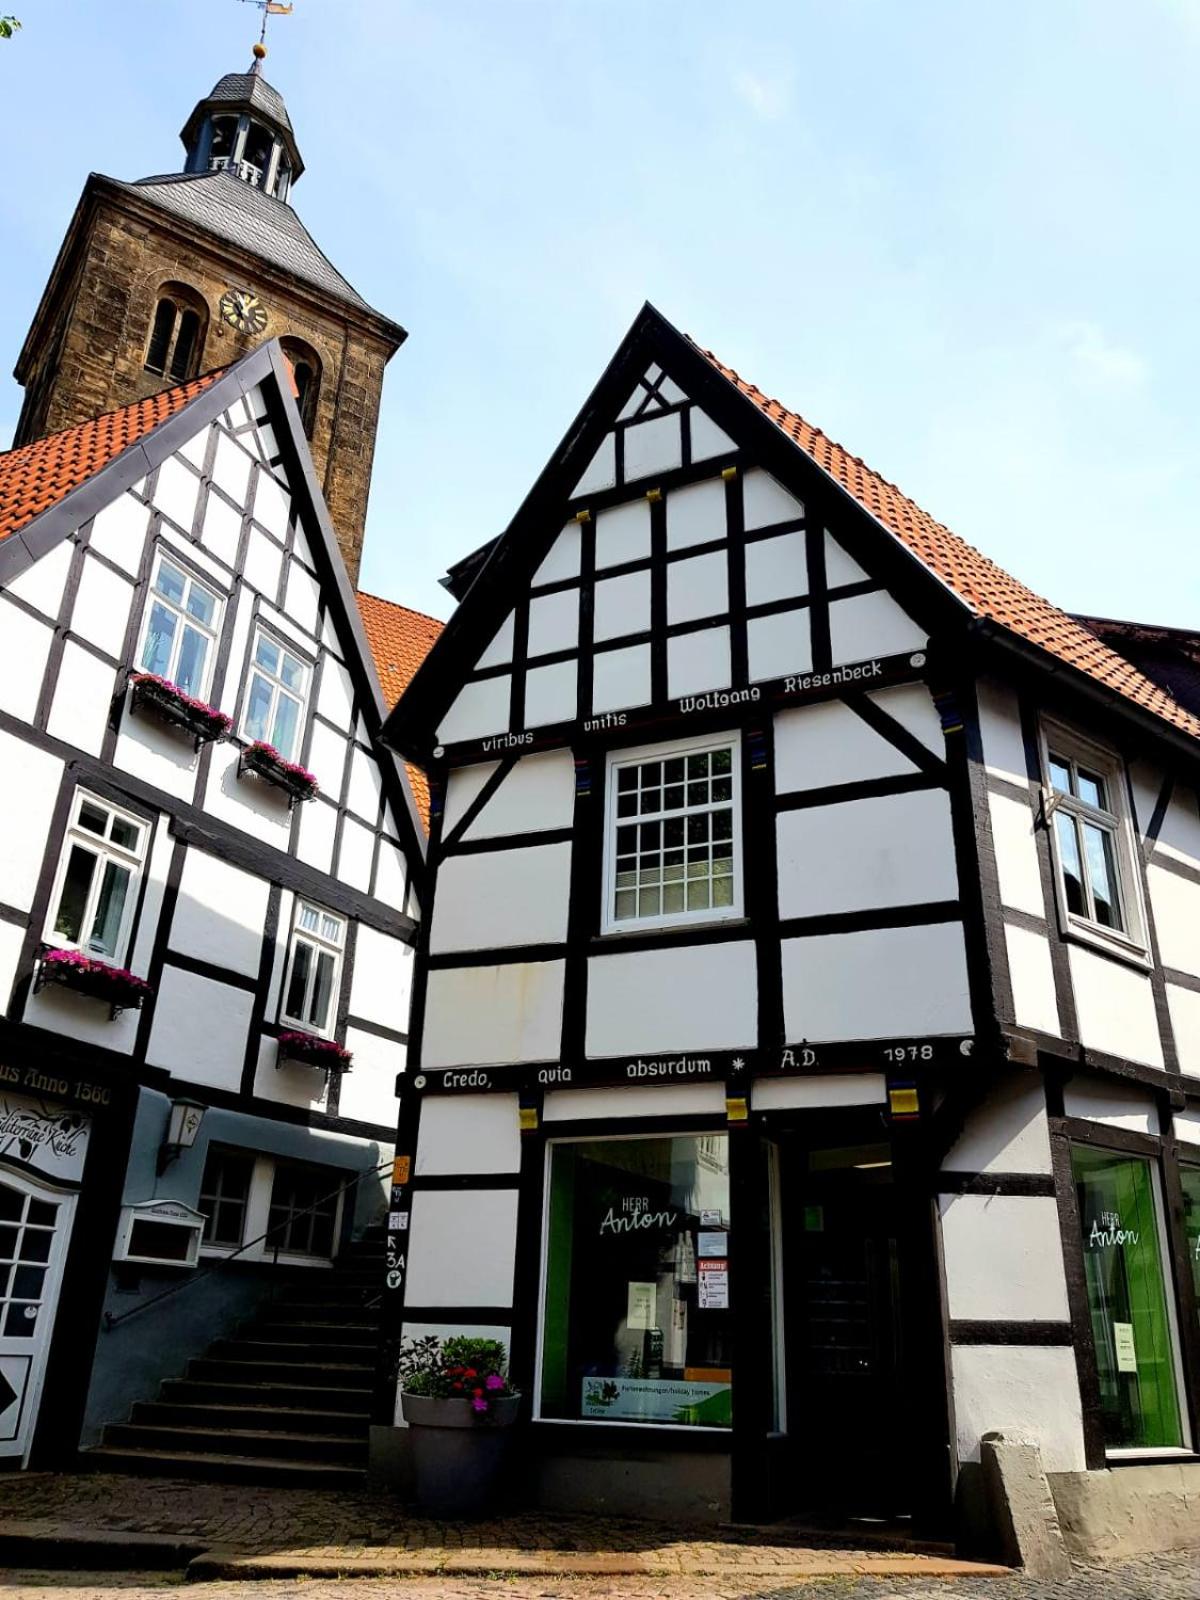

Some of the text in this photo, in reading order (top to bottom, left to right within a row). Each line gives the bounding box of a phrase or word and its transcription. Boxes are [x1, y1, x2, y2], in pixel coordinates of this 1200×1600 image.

[482, 660, 883, 752] viribus unitis Wolfgang Riesenbeck
[443, 1071, 493, 1088] Credo,
[538, 1067, 572, 1083] quia
[626, 1056, 711, 1078] absurdum
[884, 1044, 933, 1062] 1978
[24, 1068, 68, 1094] Anno
[73, 1081, 111, 1104] 1560
[623, 1197, 649, 1211] HERR
[600, 1208, 677, 1235] Anton
[1102, 1211, 1120, 1226] HERR
[1090, 1220, 1138, 1247] Anton
[386, 1251, 405, 1270] 3A
